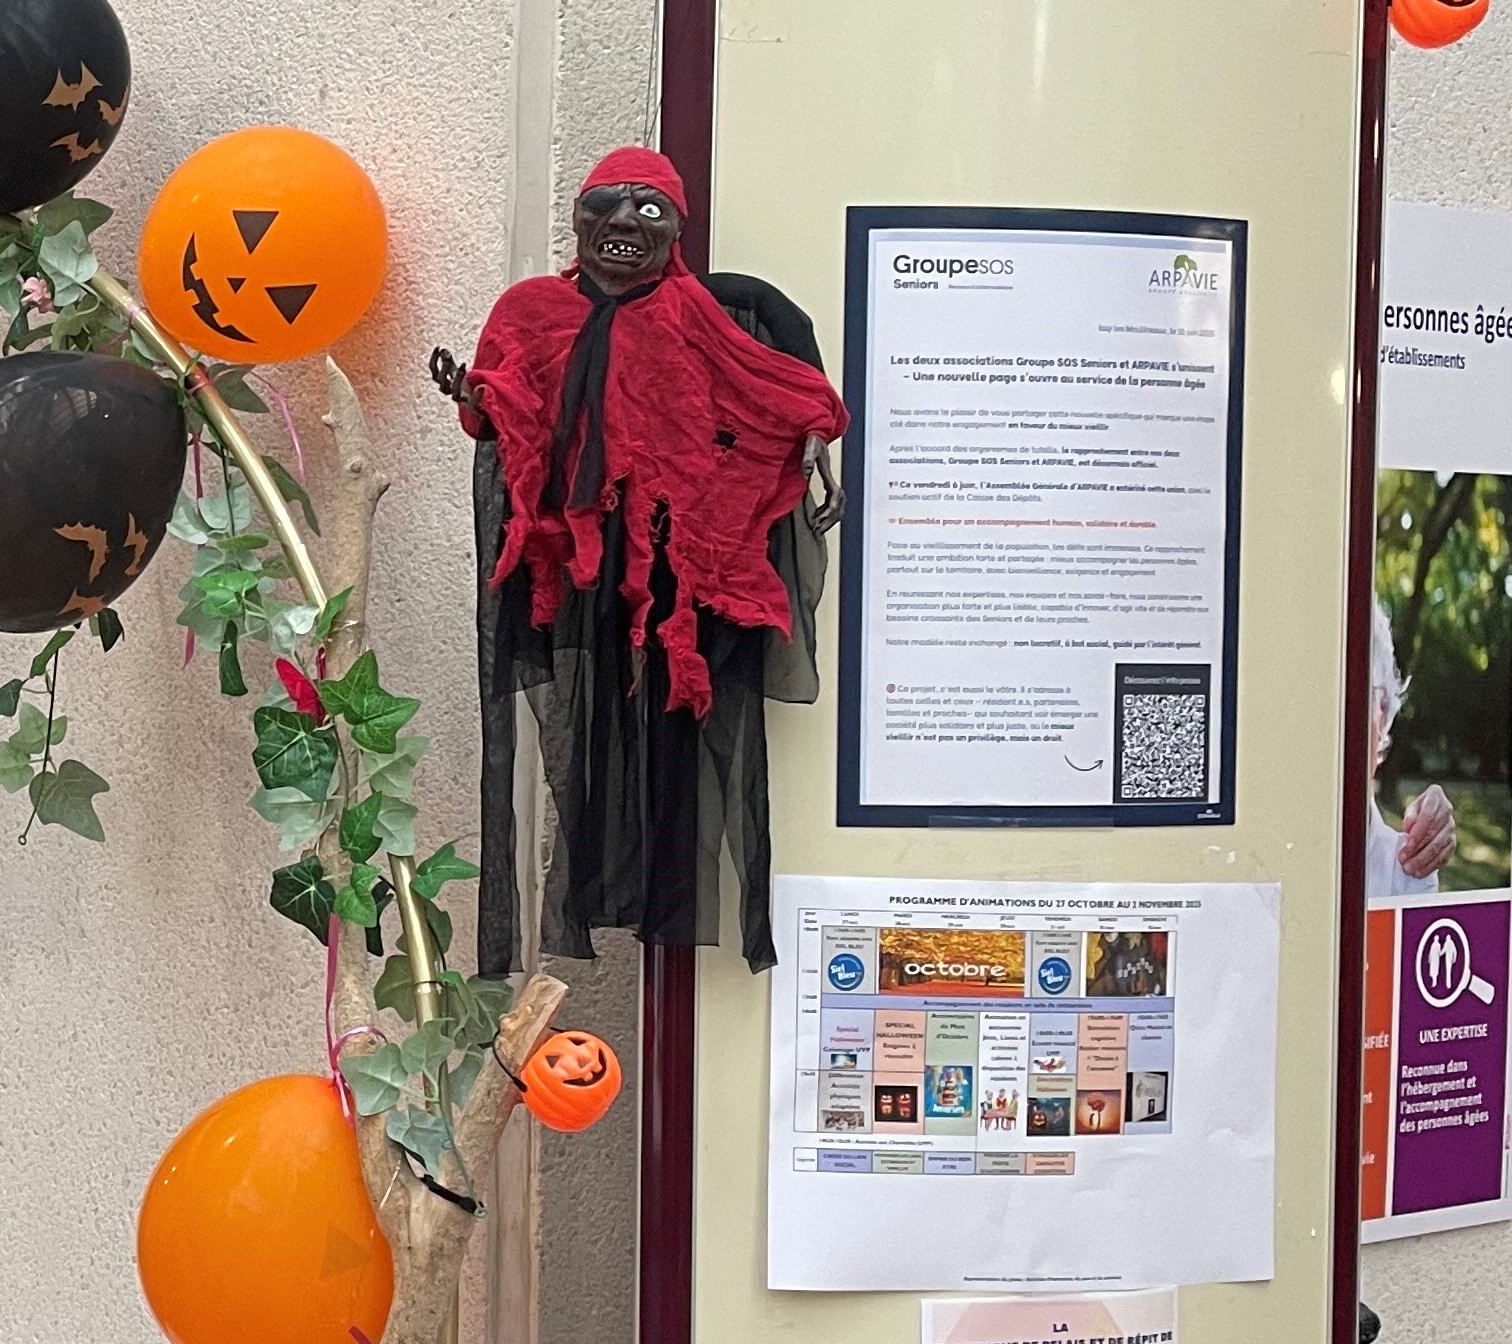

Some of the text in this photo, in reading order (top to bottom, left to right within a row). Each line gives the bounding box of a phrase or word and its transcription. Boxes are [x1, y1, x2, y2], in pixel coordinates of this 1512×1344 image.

[893, 254, 1014, 278] Groupesos
[893, 278, 939, 289] Seniors
[1148, 269, 1219, 290] ARPAVIE
[1384, 304, 1469, 335] ersonnes
[890, 355, 1170, 371] Les deux associations Groupe SOS Seniors et ARPAVIE
[912, 371, 935, 382] Une
[937, 372, 987, 382] nouvelle
[989, 374, 1017, 384] page
[1020, 372, 1058, 384] s'ouvre
[1060, 376, 1074, 384] au
[1076, 375, 1113, 385] service
[1115, 375, 1127, 386] de
[1128, 376, 1139, 386] la
[1140, 378, 1183, 388] personne
[889, 896, 957, 906] PROGRAMME
[959, 897, 1036, 908] D'ANIMATIONS
[1038, 899, 1053, 908] DU
[1067, 899, 1114, 909] OCTOBRE
[1116, 900, 1130, 909] AU
[1139, 900, 1183, 909] NOVEMBRE
[904, 962, 1007, 977] octobre
[1419, 1023, 1488, 1044] UNE EXPERTISE
[1402, 1059, 1468, 1079] Reconnue dans
[1401, 1076, 1477, 1097] l'hébergement et
[1400, 1093, 1482, 1115] l'accompagnement
[1399, 1118, 1416, 1133] des
[1417, 1114, 1463, 1133] personnes
[1053, 1323, 1069, 1333] LA
[1160, 1331, 1173, 1342] DE
